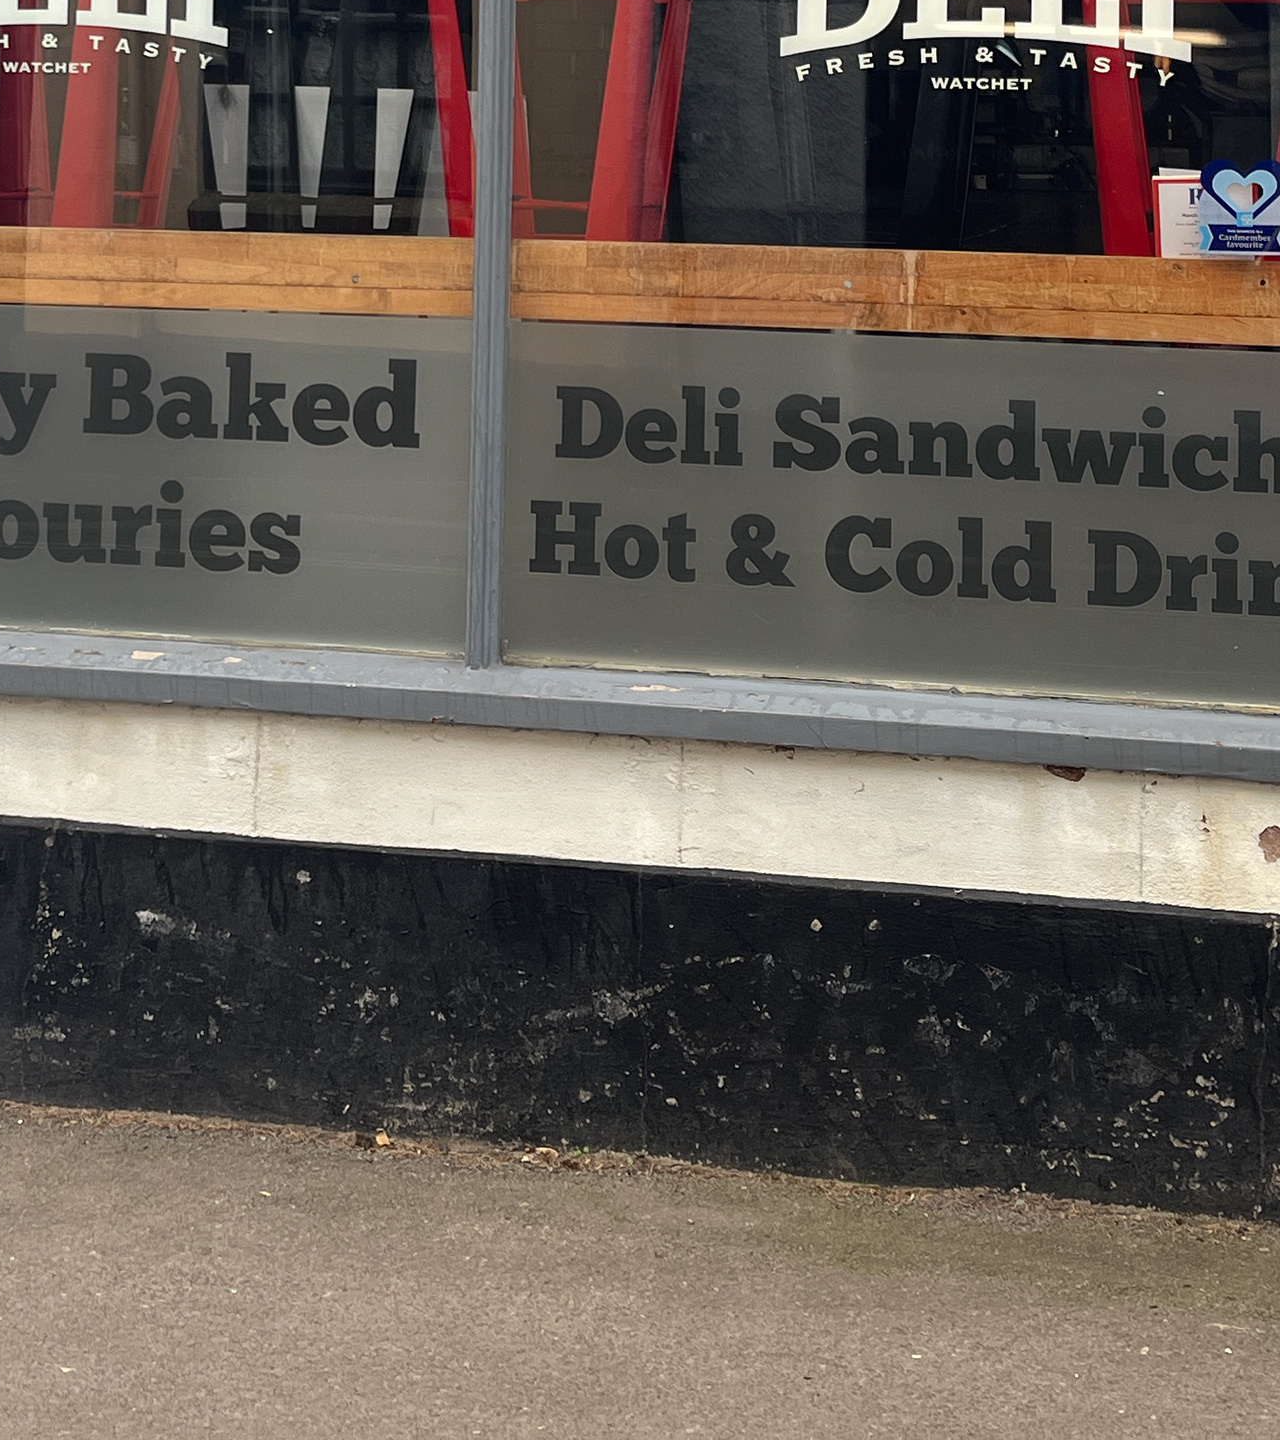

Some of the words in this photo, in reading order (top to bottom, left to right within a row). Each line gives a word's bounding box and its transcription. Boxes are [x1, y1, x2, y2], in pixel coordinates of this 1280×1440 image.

[2, 61, 91, 75] WATCHET
[41, 33, 59, 49] &
[89, 35, 214, 71] TASTY
[796, 47, 939, 82] FRESH
[975, 47, 994, 64] &
[1029, 48, 1175, 88] TASTY
[931, 77, 1032, 91] WATCHET
[1227, 241, 1264, 249] favourite
[82, 351, 421, 449] Baked
[554, 385, 743, 467] Deli
[528, 500, 697, 585] Hot
[725, 513, 796, 589] &
[824, 515, 1057, 604] Cold
